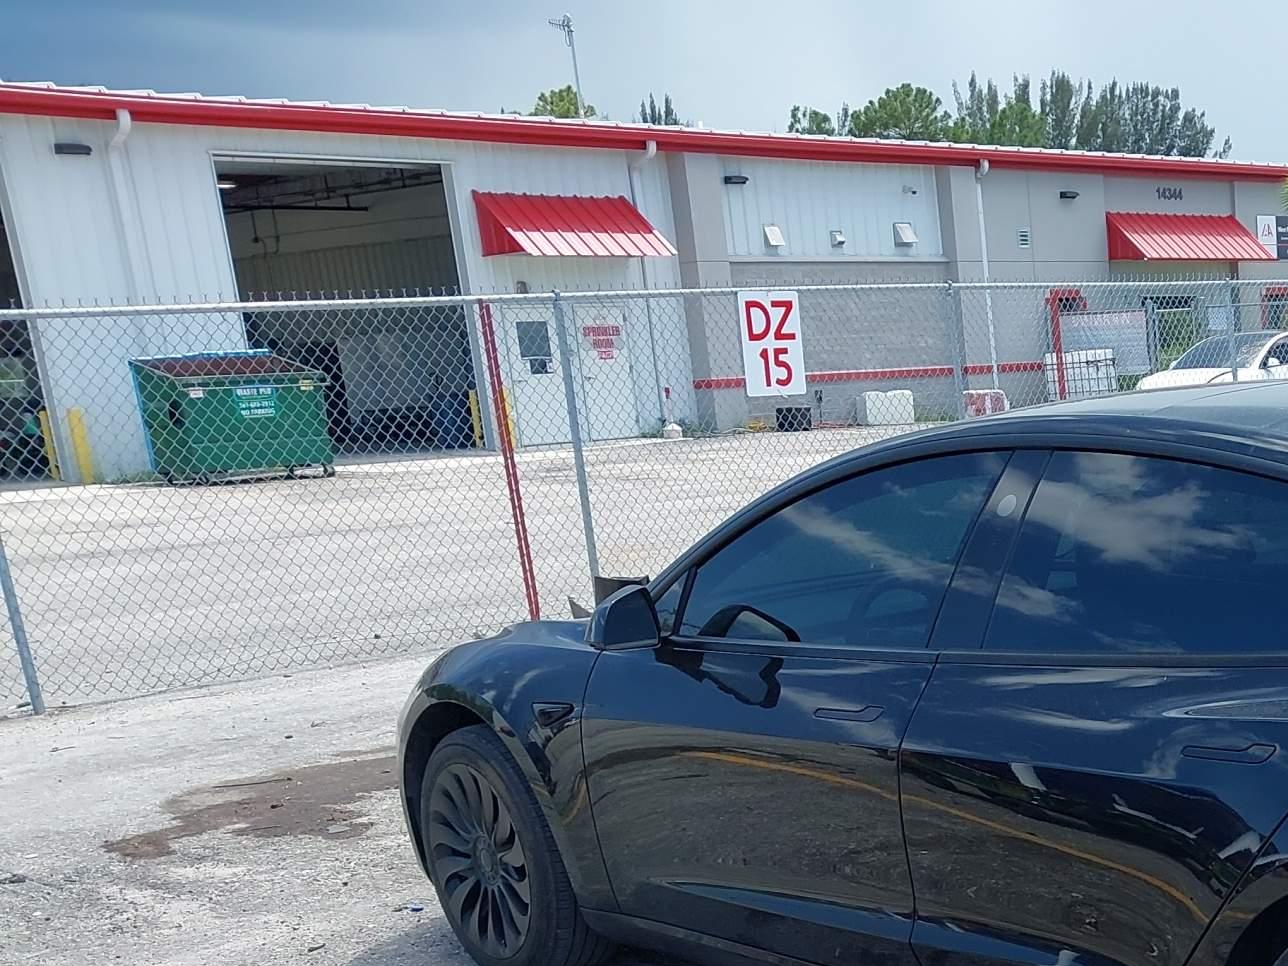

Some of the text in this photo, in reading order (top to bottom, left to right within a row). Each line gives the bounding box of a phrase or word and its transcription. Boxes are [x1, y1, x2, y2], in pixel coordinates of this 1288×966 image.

[1156, 187, 1184, 201] 14344
[744, 300, 797, 342] DZ
[582, 326, 621, 337] SPRINKLER
[592, 338, 614, 349] ROOM
[759, 347, 793, 387] 15
